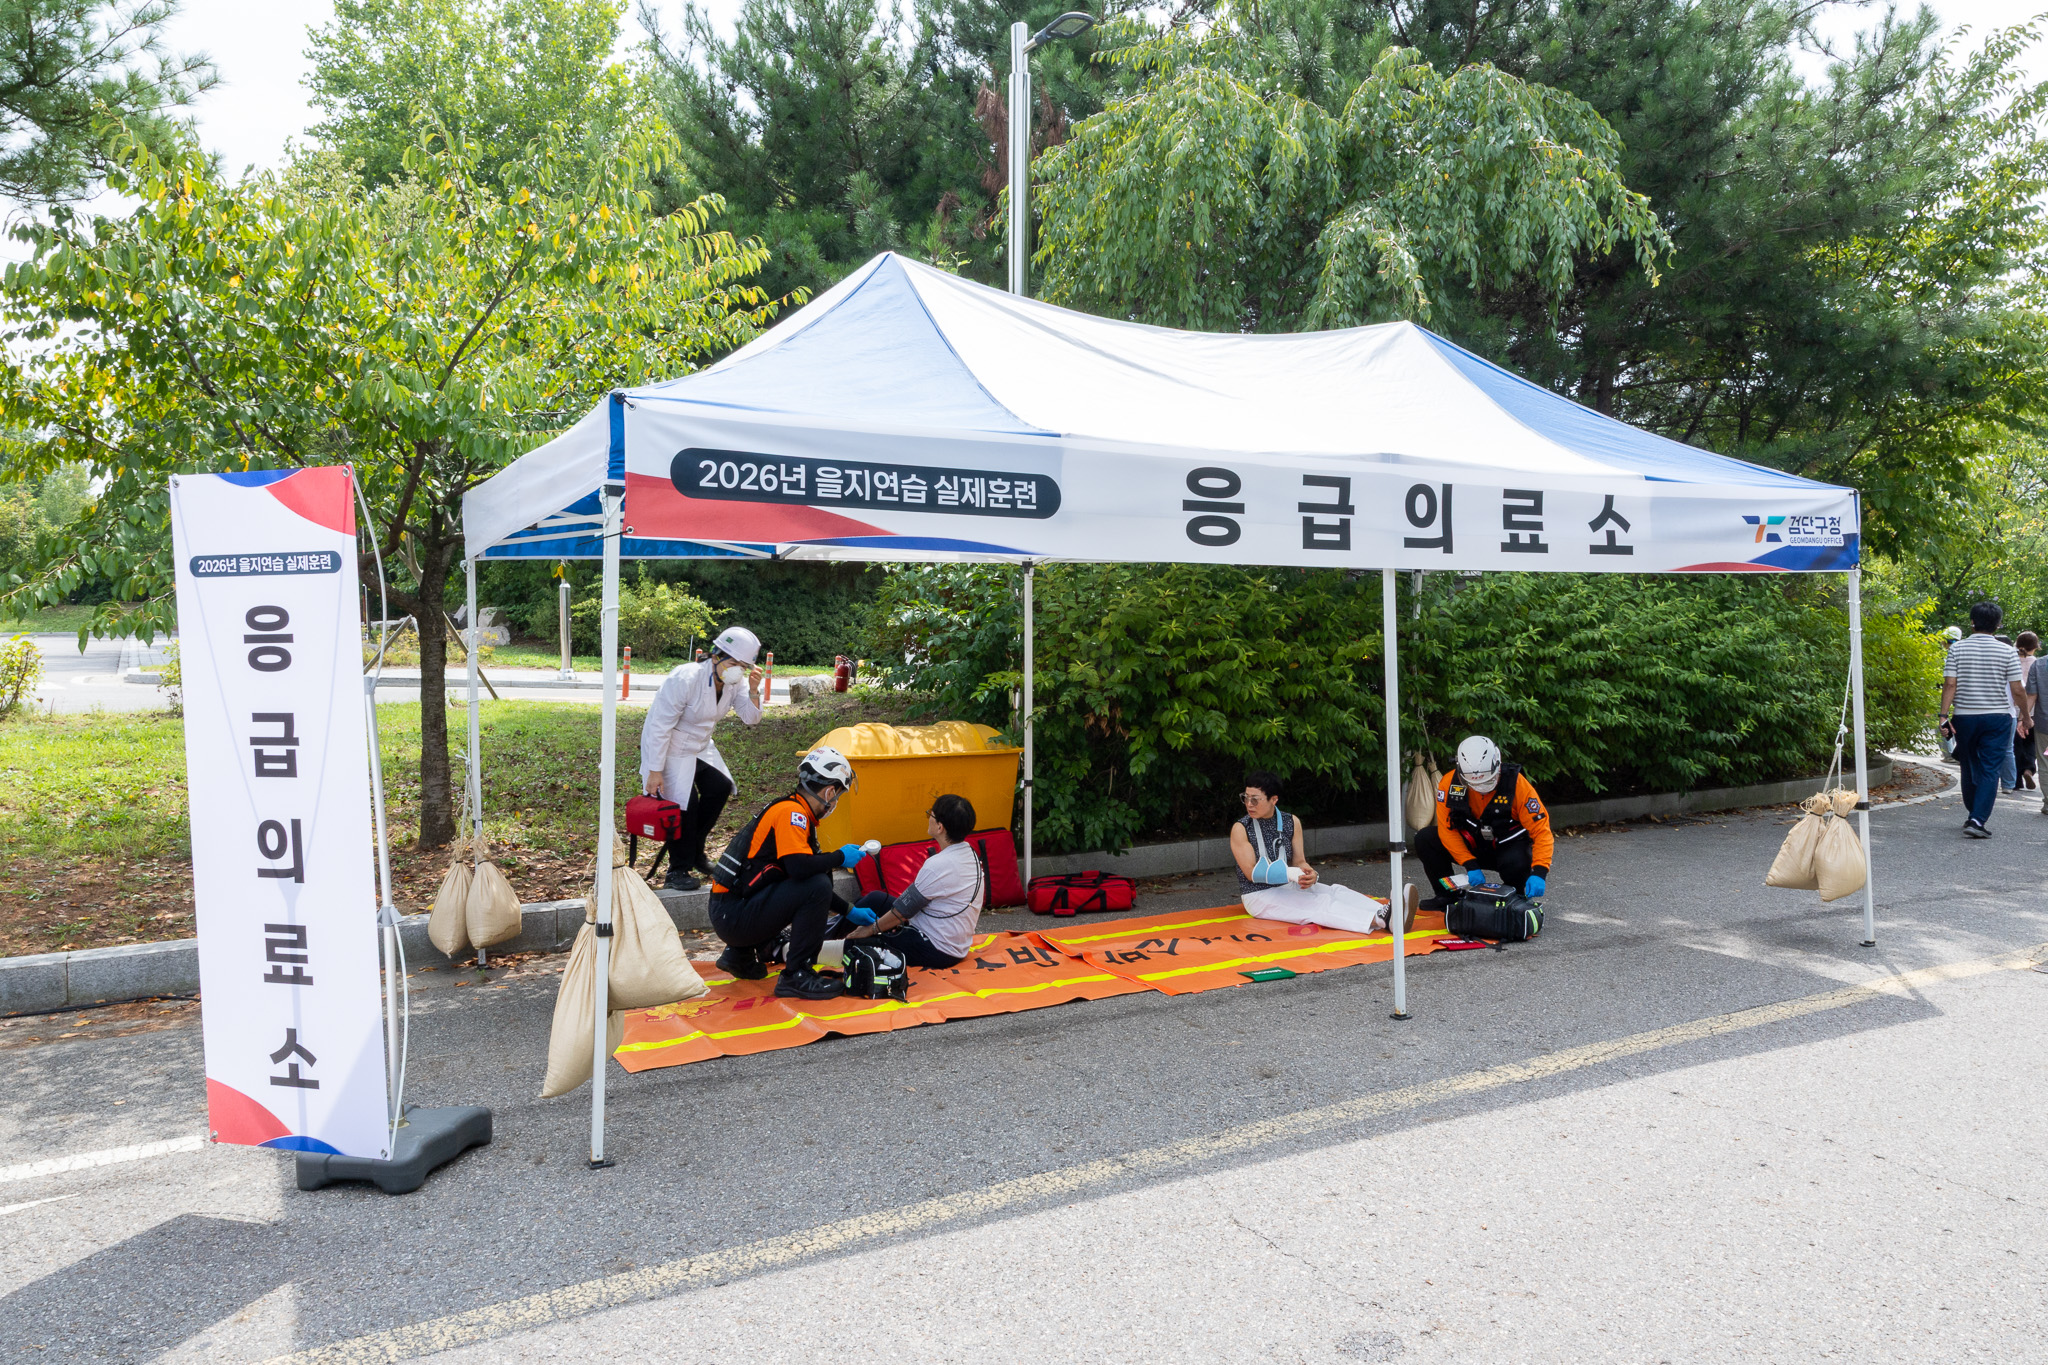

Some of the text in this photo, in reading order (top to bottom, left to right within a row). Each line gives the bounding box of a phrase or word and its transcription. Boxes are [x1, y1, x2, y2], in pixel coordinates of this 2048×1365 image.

[698, 459, 1037, 510] 2026년 을지연습 실제훈련
[1789, 516, 1841, 535] 검단구청
[198, 553, 332, 573] 2026년 을지연습 실제훈련
